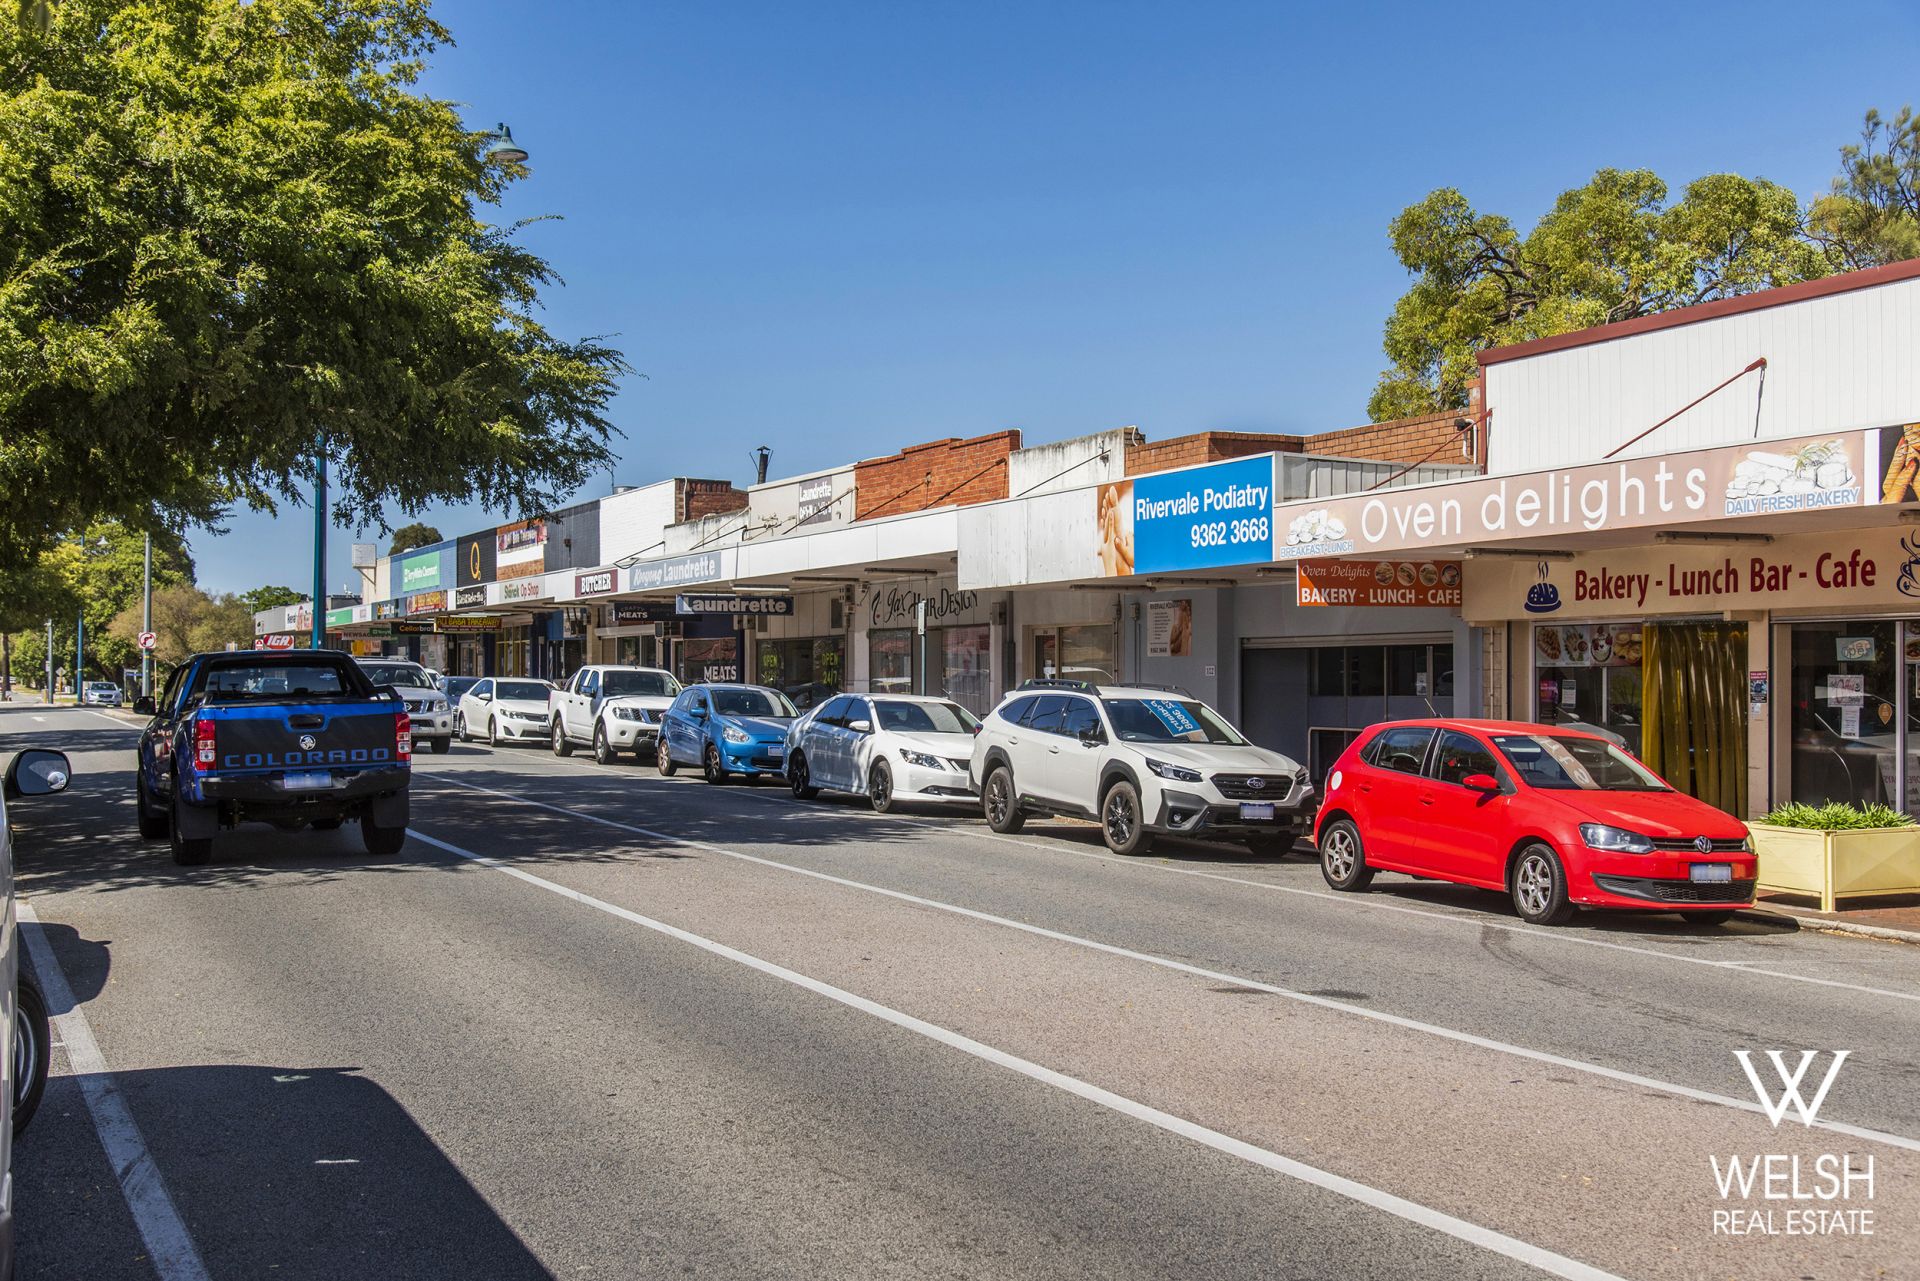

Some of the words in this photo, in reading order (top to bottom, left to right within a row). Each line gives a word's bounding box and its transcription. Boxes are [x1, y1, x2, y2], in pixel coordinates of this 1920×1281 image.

[1136, 491, 1199, 521] Rivervale
[1203, 483, 1268, 512] Podiatry
[1361, 499, 1461, 543] Oven
[1481, 461, 1706, 531] delights
[1726, 498, 1758, 515] DAILY
[1761, 494, 1802, 512] FRESH
[1805, 487, 1860, 508] BAKERY
[1191, 521, 1227, 548] 9362
[1230, 516, 1269, 544] 3668
[663, 555, 716, 581] Laundrette
[1301, 564, 1327, 577] Oven
[1331, 563, 1371, 581] Delights
[581, 572, 611, 595] BUTCHER
[1575, 567, 1649, 608] Bakery
[1669, 558, 1739, 596] Lunch
[1750, 557, 1792, 592] Bar
[1816, 549, 1876, 589] Cafe
[521, 583, 528, 599] Op
[528, 582, 539, 598] Shop
[1301, 587, 1357, 603] BAKERY
[1369, 588, 1415, 603] LUNCH
[1428, 588, 1461, 604] CAFE
[682, 596, 787, 613] Laundrette
[908, 591, 939, 620] HIR
[937, 587, 978, 617] DESIGN
[618, 611, 648, 619] MEATS
[400, 625, 433, 633] Cellarbra
[267, 634, 290, 646] IGA
[703, 665, 736, 680] MEATS
[224, 748, 389, 768] COLORADO
